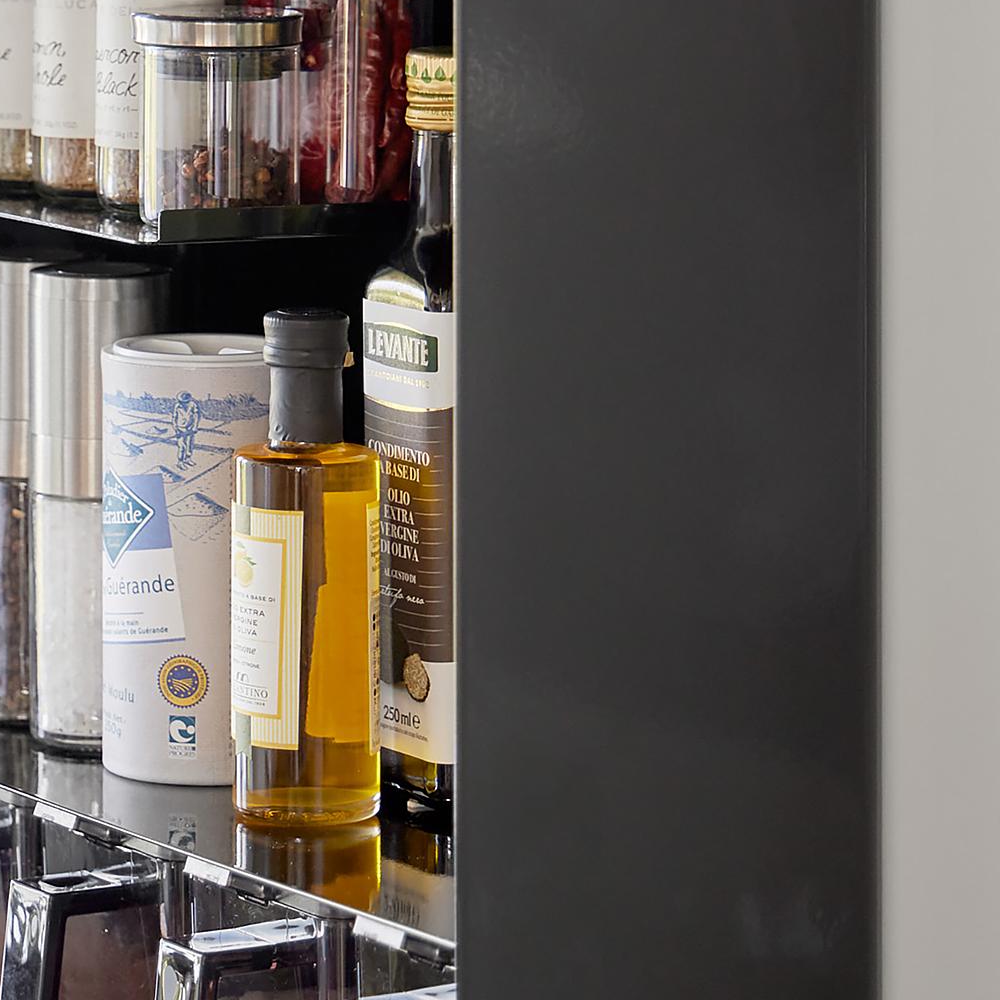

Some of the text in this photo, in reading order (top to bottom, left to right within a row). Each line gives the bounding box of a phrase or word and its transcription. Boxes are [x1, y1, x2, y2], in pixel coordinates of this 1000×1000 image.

[367, 327, 430, 368] LEVANTE
[368, 438, 430, 467] CONDIMENTO
[385, 460, 409, 480] BASE
[409, 466, 420, 483] DI
[387, 487, 411, 506] OLIO
[383, 504, 415, 525] EXTRA
[380, 520, 420, 544] VERGINE
[380, 538, 420, 562] DI OLIVA
[240, 606, 266, 617] EXTRA
[138, 626, 169, 635] Guérande
